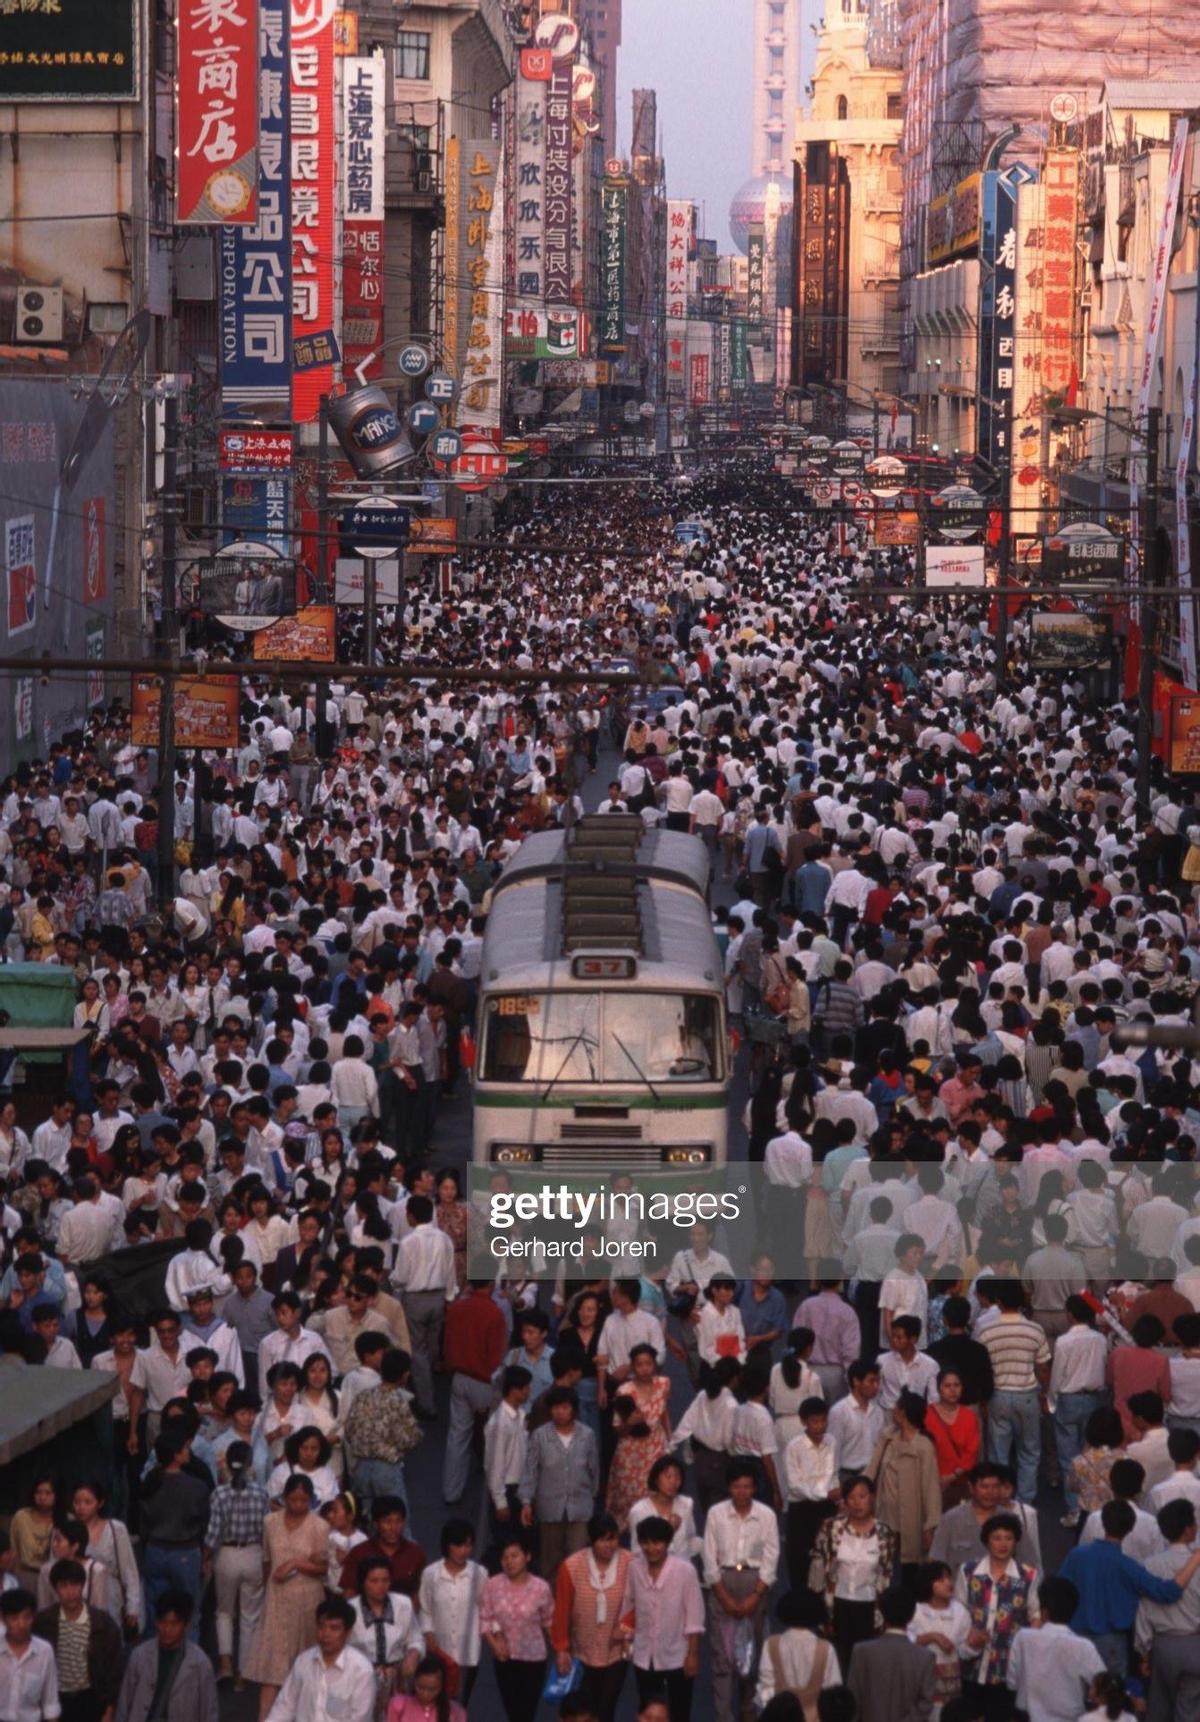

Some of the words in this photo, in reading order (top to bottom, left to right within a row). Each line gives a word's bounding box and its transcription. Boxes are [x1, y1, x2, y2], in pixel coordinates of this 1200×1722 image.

[347, 67, 373, 214] 上海冠心药房
[604, 190, 622, 341] 上海市第一医药商店
[430, 379, 453, 397] 正
[1068, 543, 1119, 558] 杉杉西服
[583, 960, 622, 974] 37
